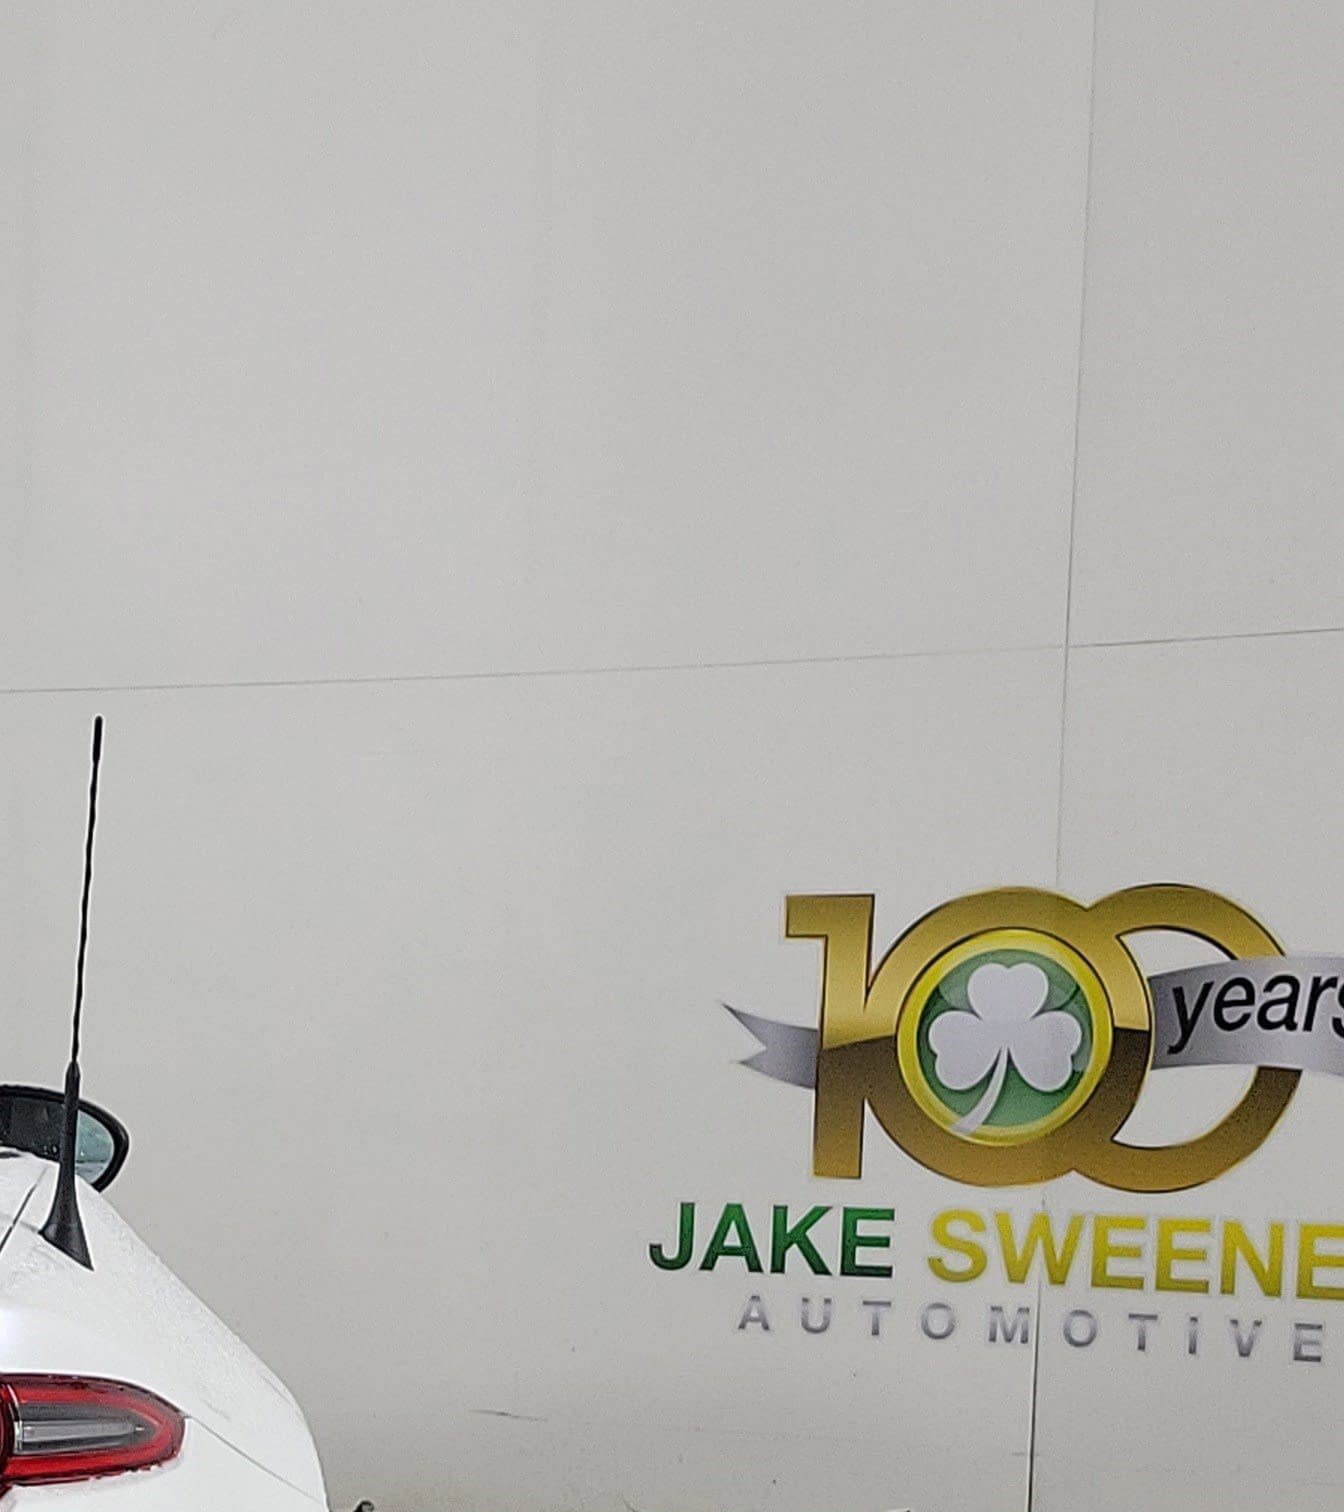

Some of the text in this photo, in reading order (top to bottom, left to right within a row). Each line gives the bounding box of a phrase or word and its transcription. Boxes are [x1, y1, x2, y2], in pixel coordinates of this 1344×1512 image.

[785, 883, 1302, 1192] 100
[649, 1202, 895, 1277] JAKE
[737, 1295, 1323, 1363] AUTOMOTIVE
